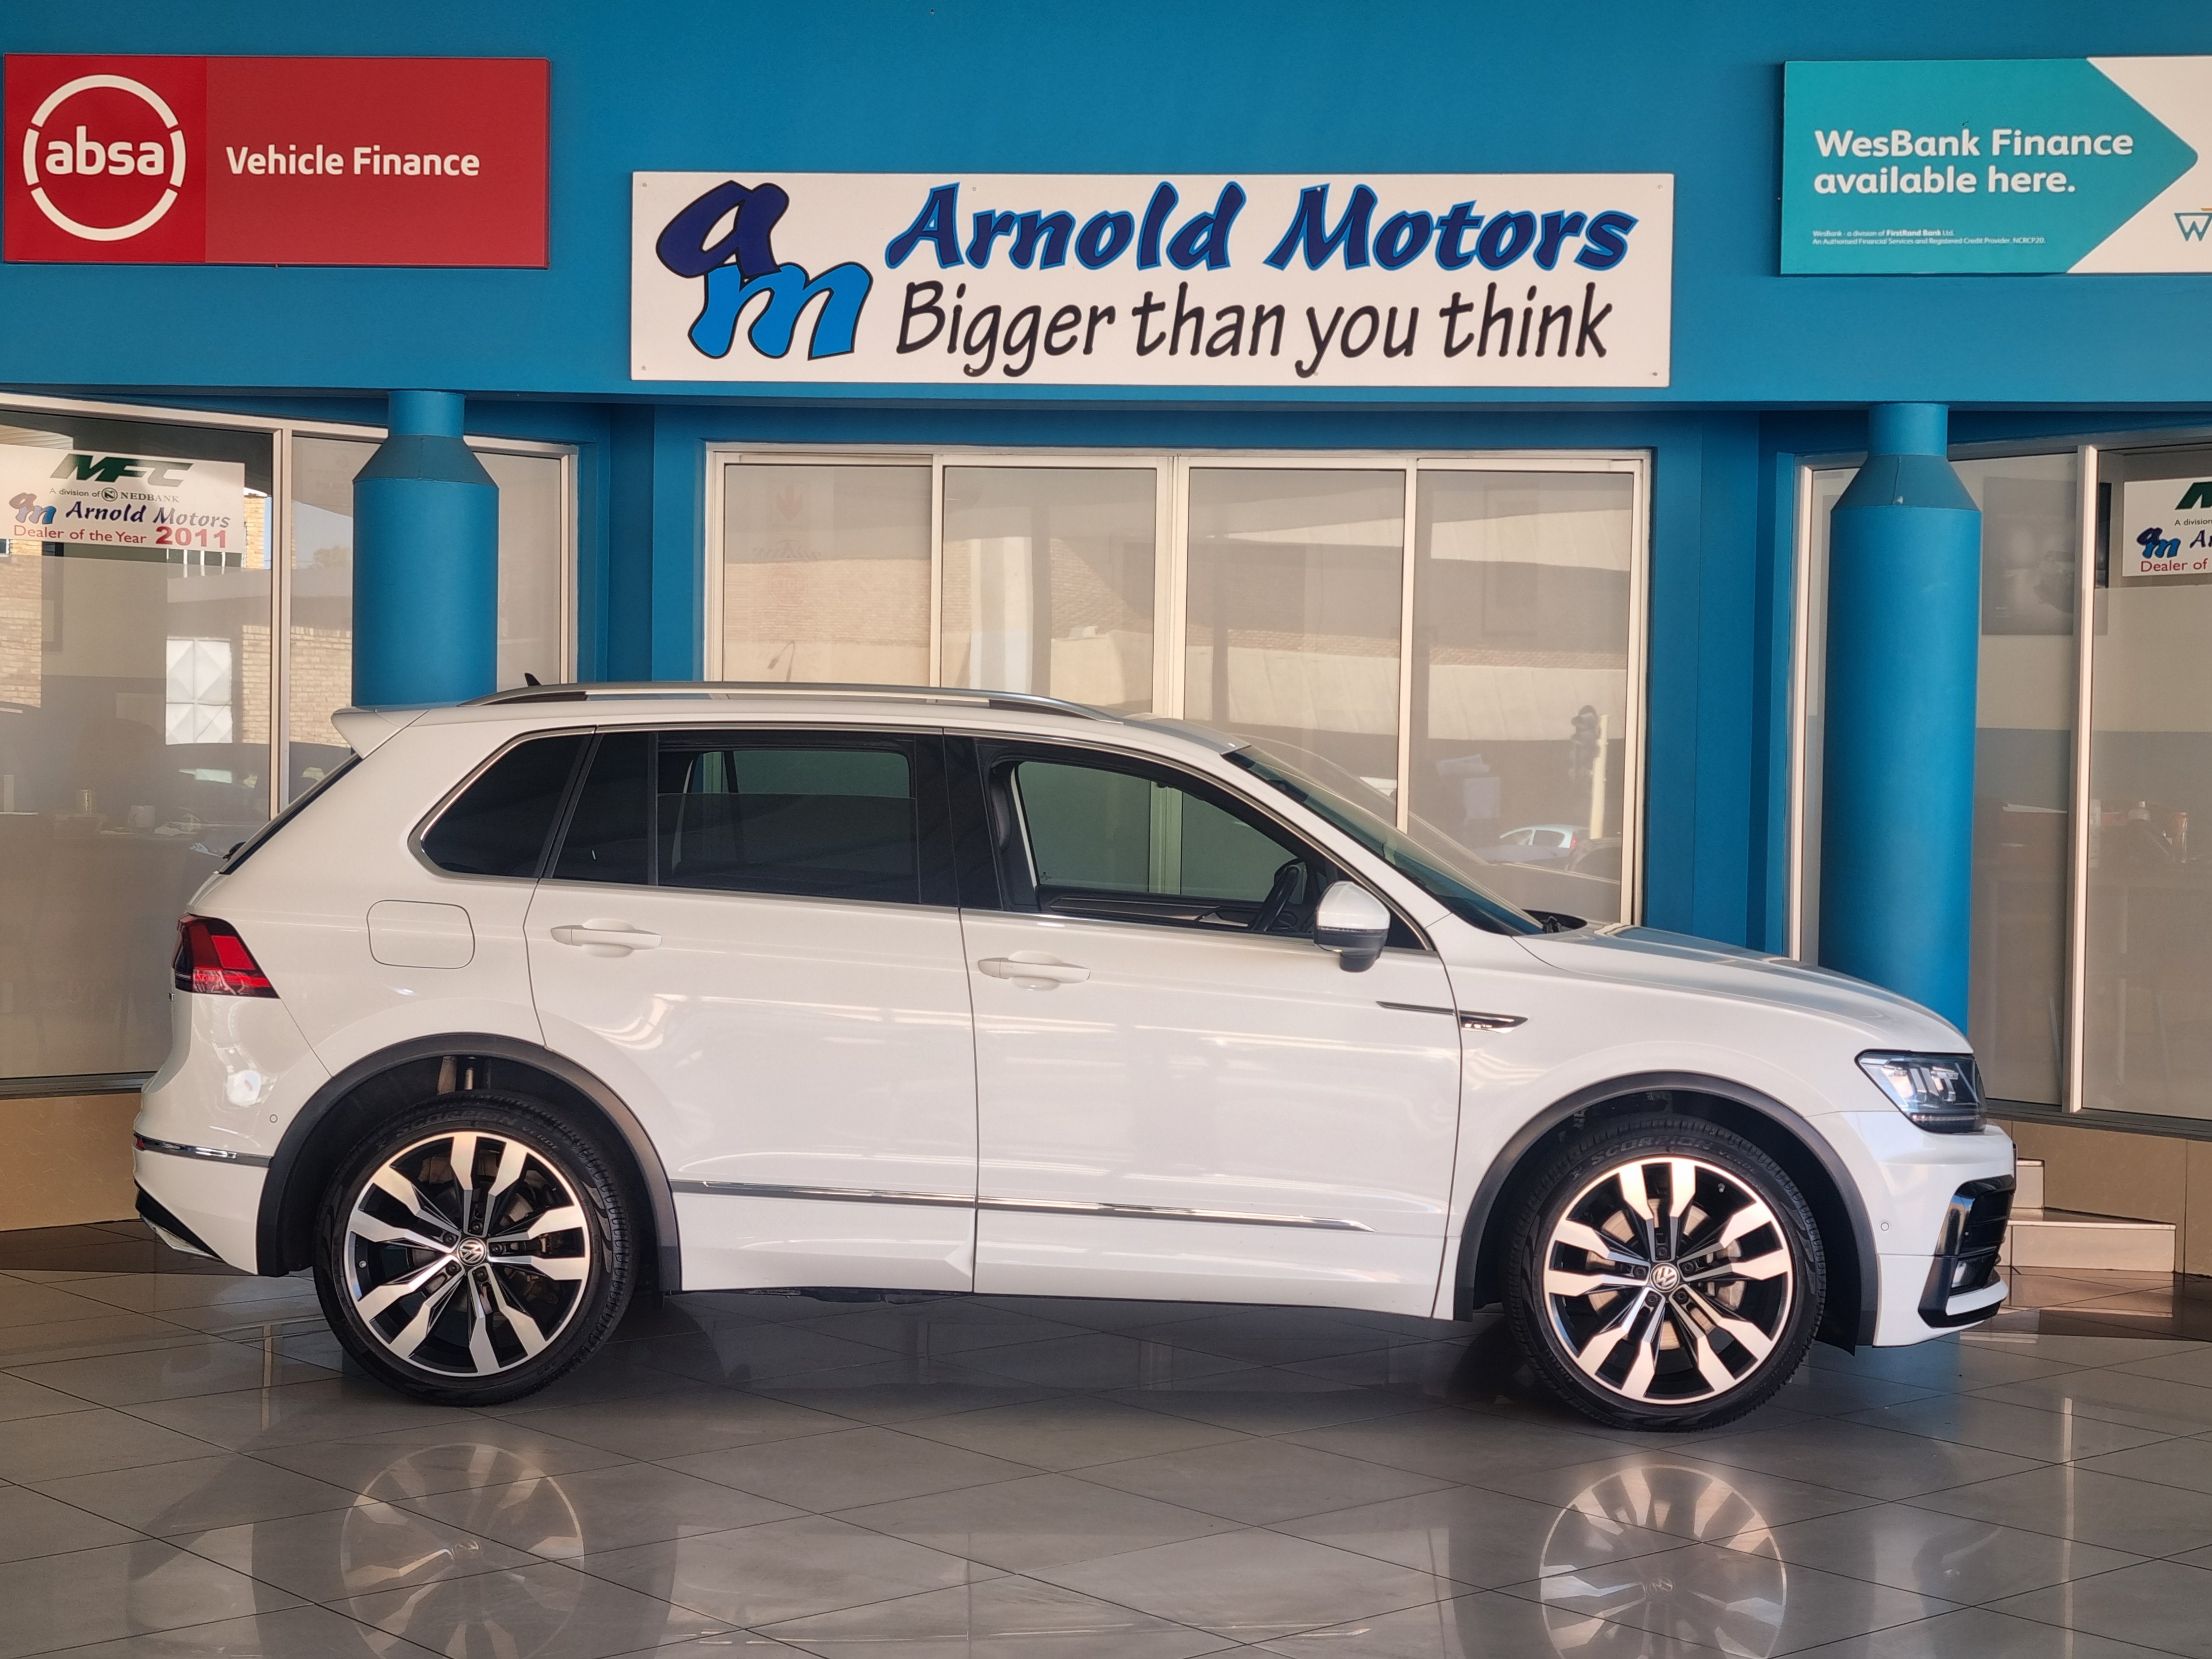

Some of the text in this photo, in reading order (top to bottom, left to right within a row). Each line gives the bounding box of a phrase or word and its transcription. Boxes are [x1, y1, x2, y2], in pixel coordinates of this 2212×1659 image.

[45, 125, 165, 176] absa
[1815, 128, 2134, 157] WesBank Finance
[226, 145, 480, 176] Vehicle Finance
[1814, 165, 2076, 194] available here.
[885, 182, 1639, 271] Arnold Motors
[1929, 237, 1962, 246] Registered
[896, 281, 1613, 378] Bigger than you think
[50, 453, 194, 487] MFC
[120, 492, 179, 503] NEDBANK
[65, 501, 147, 523] Arnold
[152, 506, 231, 528] Motors
[13, 525, 226, 548] Dealer of the Year 2011
[2141, 558, 2209, 572] Dealer of
